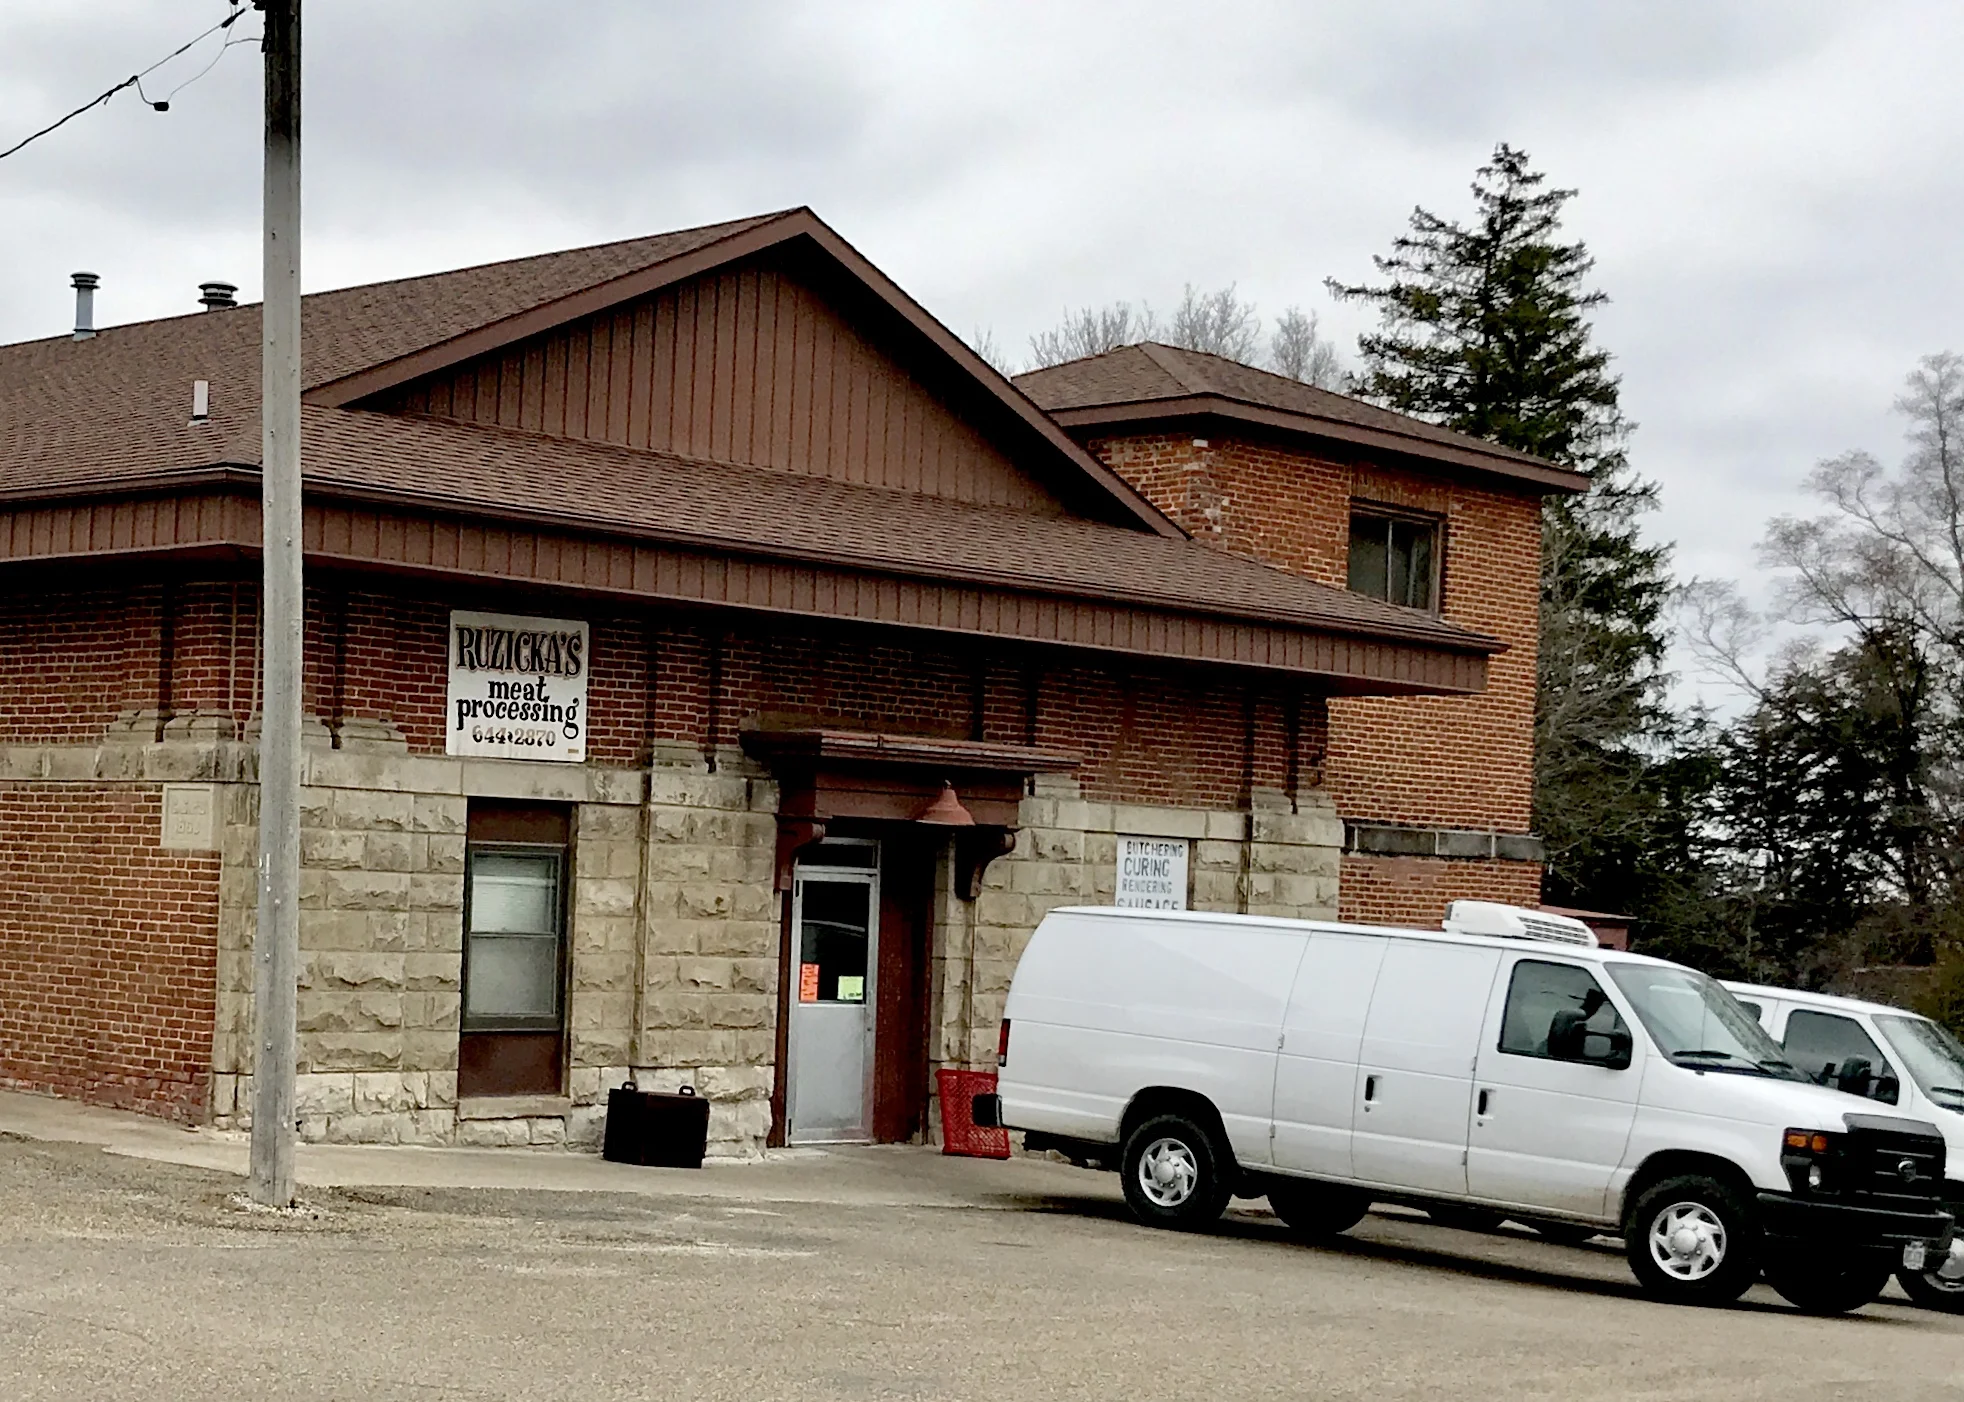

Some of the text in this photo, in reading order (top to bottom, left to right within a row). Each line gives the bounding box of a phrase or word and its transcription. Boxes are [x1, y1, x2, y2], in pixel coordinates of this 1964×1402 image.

[455, 624, 583, 679] RUZICKA'S
[488, 676, 549, 703] meat
[456, 698, 579, 740] processing
[1126, 841, 1184, 857] BUTCHERING
[1124, 857, 1170, 877] CURING
